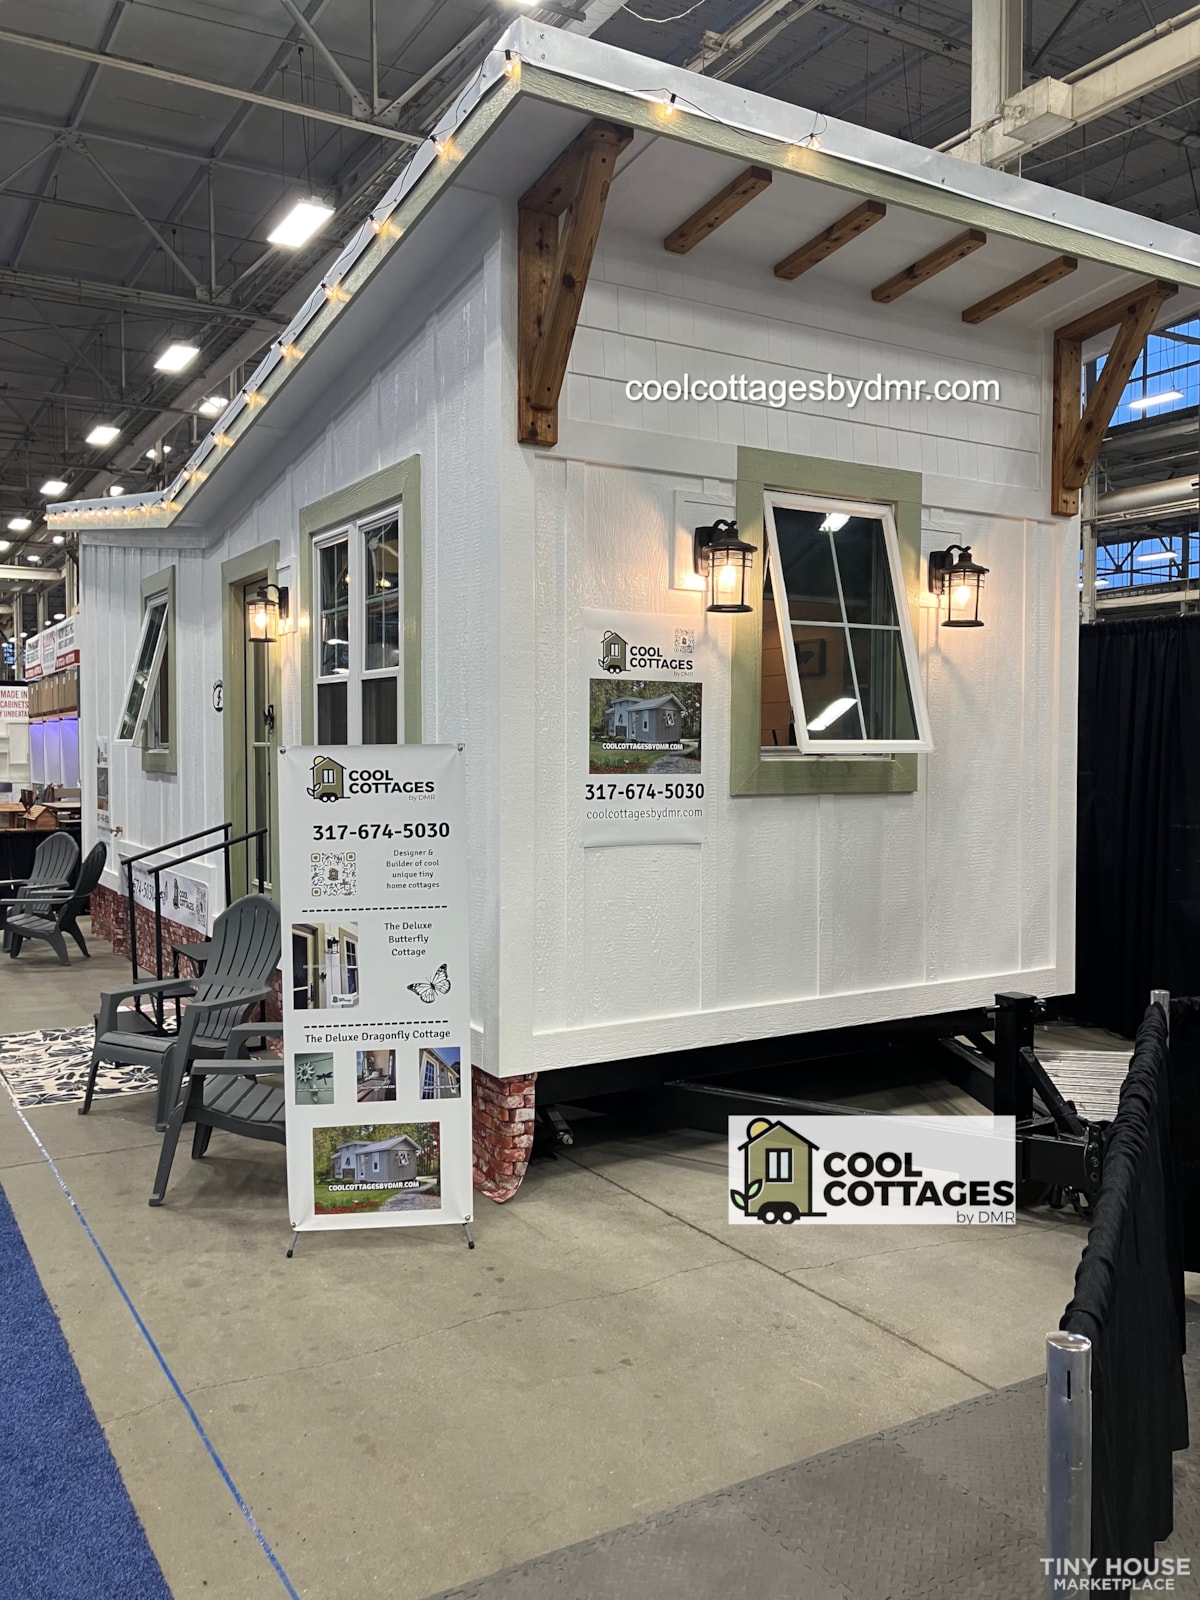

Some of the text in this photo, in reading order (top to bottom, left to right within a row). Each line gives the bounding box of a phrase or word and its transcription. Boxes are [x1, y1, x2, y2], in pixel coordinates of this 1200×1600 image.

[630, 646, 663, 658] COOL
[630, 658, 693, 670] COTTAGES
[0, 690, 20, 699] MADE
[4, 710, 29, 718] UNBEATA
[602, 742, 684, 751] COOLCOTTAGESBYDMR.COM
[348, 769, 394, 782] COOL
[348, 781, 435, 794] COTTAGES
[585, 783, 705, 800] 317-674-5030
[586, 807, 703, 821] coolcottagesbydmr.com
[312, 822, 450, 841] 317-674-5030
[393, 849, 426, 858] Designer
[386, 859, 440, 868] Builder of cool
[392, 871, 434, 880] unique tiny
[386, 881, 440, 890] home cottages
[384, 921, 432, 931] The Deluxe
[388, 934, 429, 945] Butterfly
[391, 948, 426, 957] Cottage
[305, 1029, 451, 1043] The Deluxe Dragonfly Cottage
[328, 1180, 420, 1192] COOLCOTTAGESBYDMR.COM
